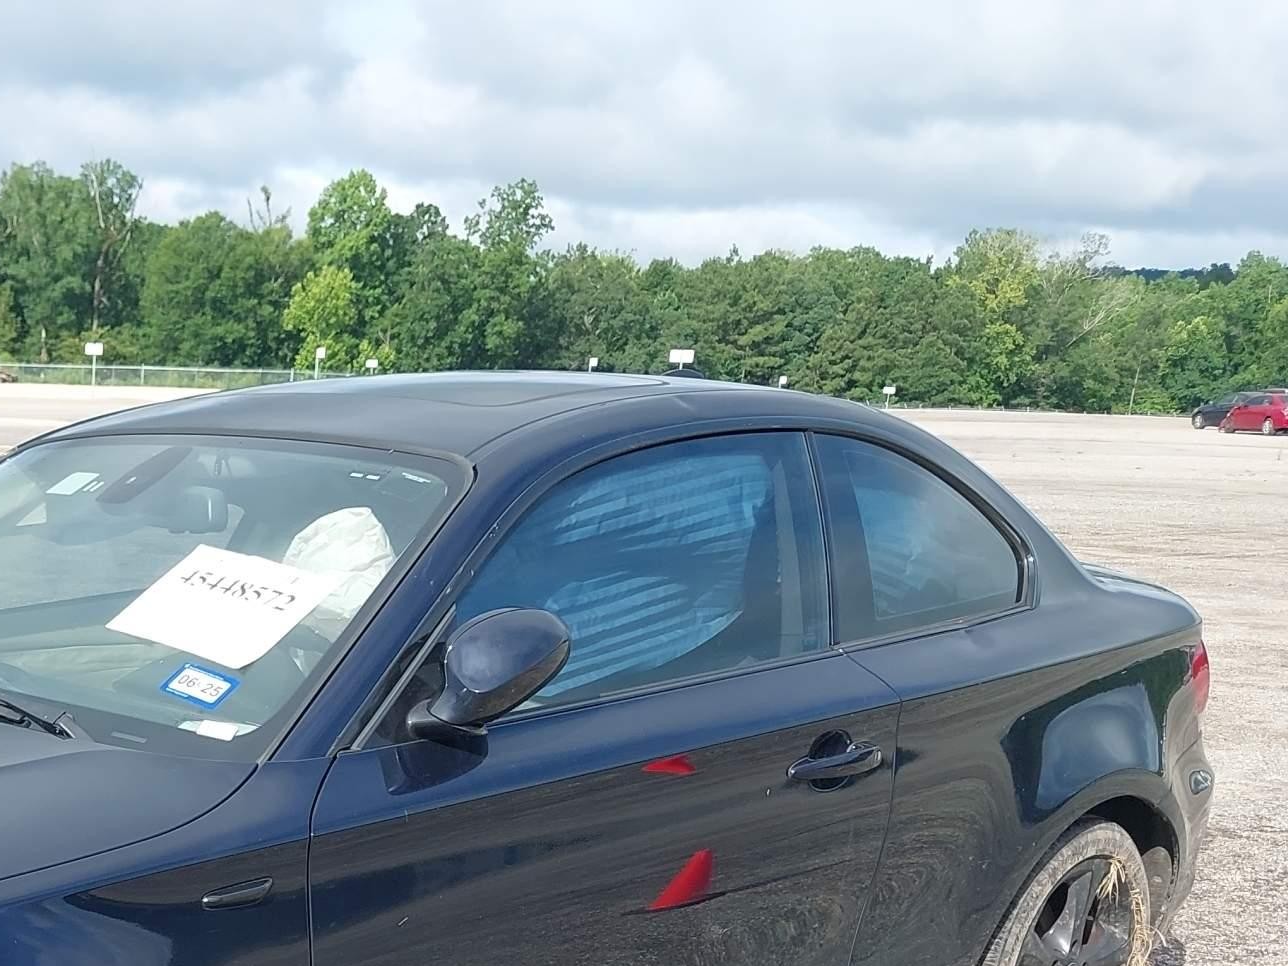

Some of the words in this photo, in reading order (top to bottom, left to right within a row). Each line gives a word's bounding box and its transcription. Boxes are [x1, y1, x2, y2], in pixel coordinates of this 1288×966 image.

[180, 569, 296, 612] 45448572
[177, 674, 199, 688] 06
[200, 683, 224, 697] 25
